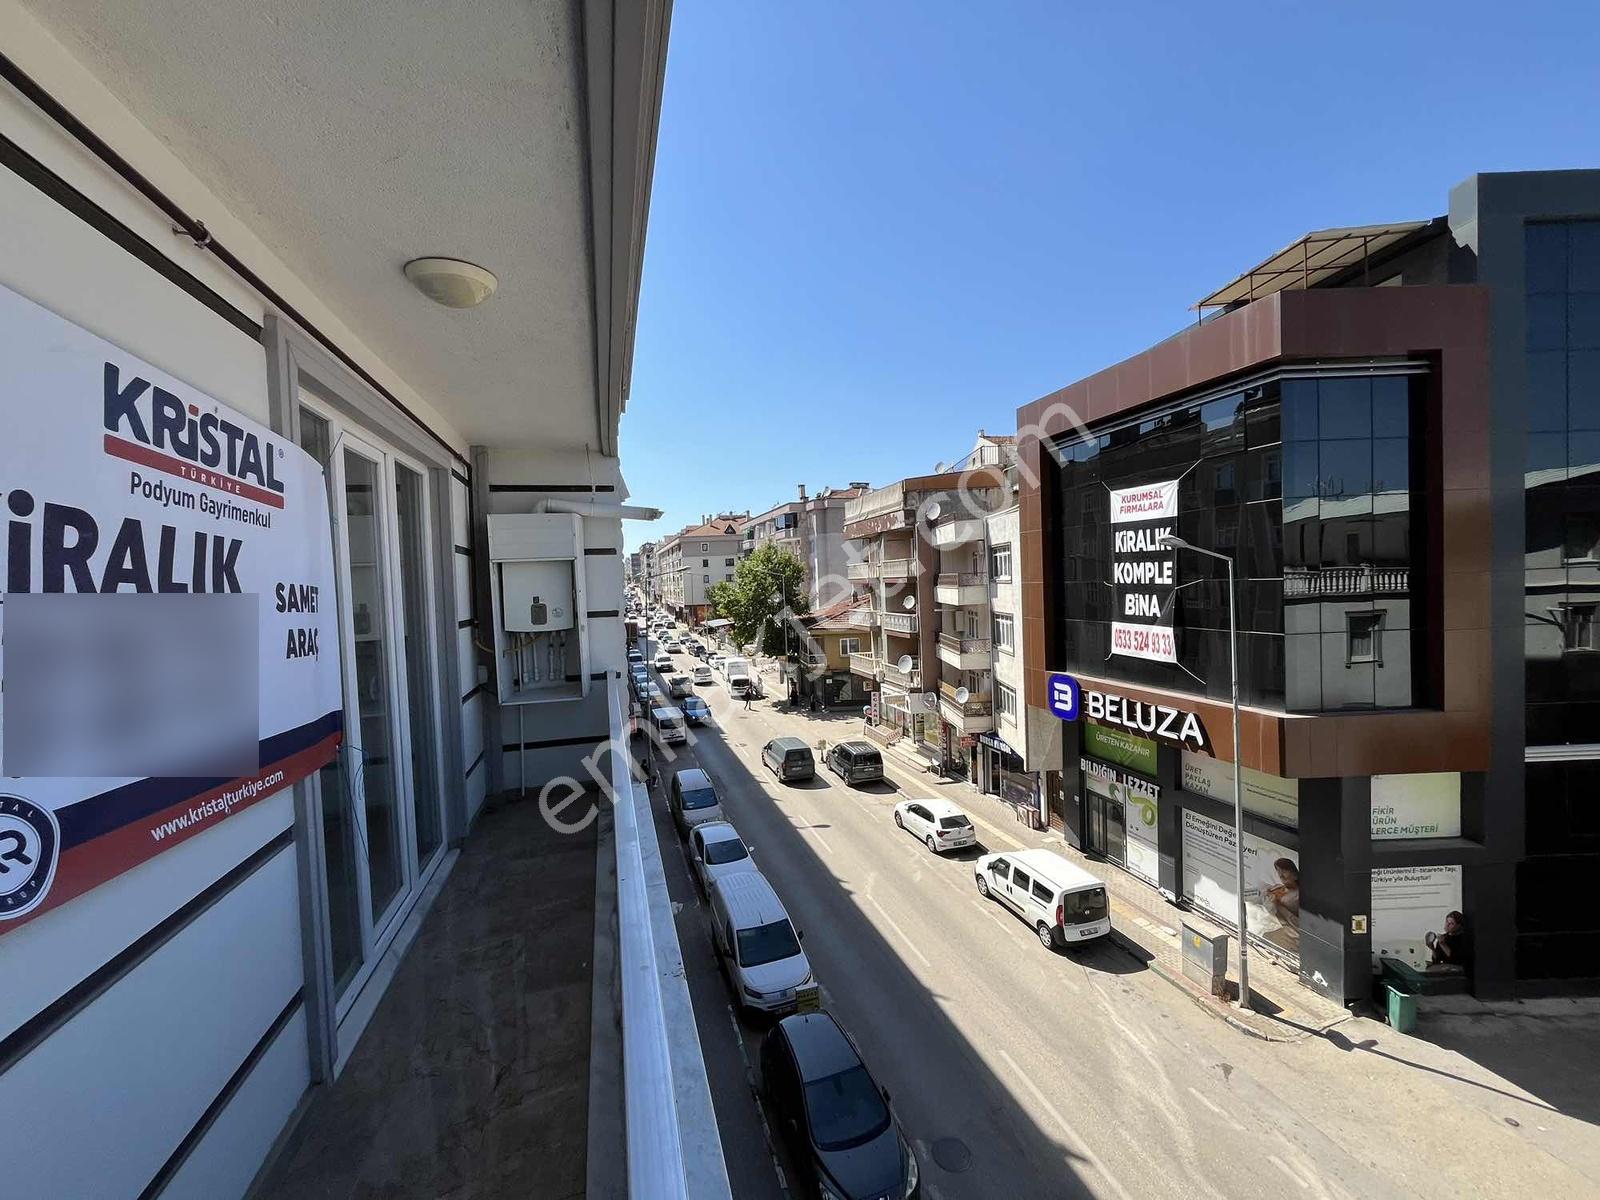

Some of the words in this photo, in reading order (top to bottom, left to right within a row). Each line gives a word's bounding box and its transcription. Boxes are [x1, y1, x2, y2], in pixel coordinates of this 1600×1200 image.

[180, 466, 241, 494] TÜRKİYE
[131, 471, 195, 509] Podyum
[200, 492, 271, 528] Gayrimenkul
[1121, 490, 1163, 504] KURUMSAL
[1114, 561, 1173, 584] KOMPLE
[275, 582, 319, 613] SAMET
[1115, 628, 1131, 650] 0533
[1134, 630, 1149, 652] 524
[1152, 632, 1160, 653] 93
[1162, 633, 1172, 656] 33
[1087, 690, 1204, 747] BELUZA
[1095, 731, 1120, 747] ÜRETEN
[1123, 773, 1160, 801] LEZZET
[151, 769, 284, 841] www.kristalturkiye.com
[1372, 805, 1394, 815] FİKİR
[1192, 815, 1217, 830] Emeğini
[1219, 825, 1237, 839] Değe
[1372, 816, 1397, 825] ÜRÜN
[1400, 823, 1439, 835] MÜŞTERİ
[1185, 821, 1223, 842] Dönüştüren
[1225, 836, 1258, 857] Pazyeri
